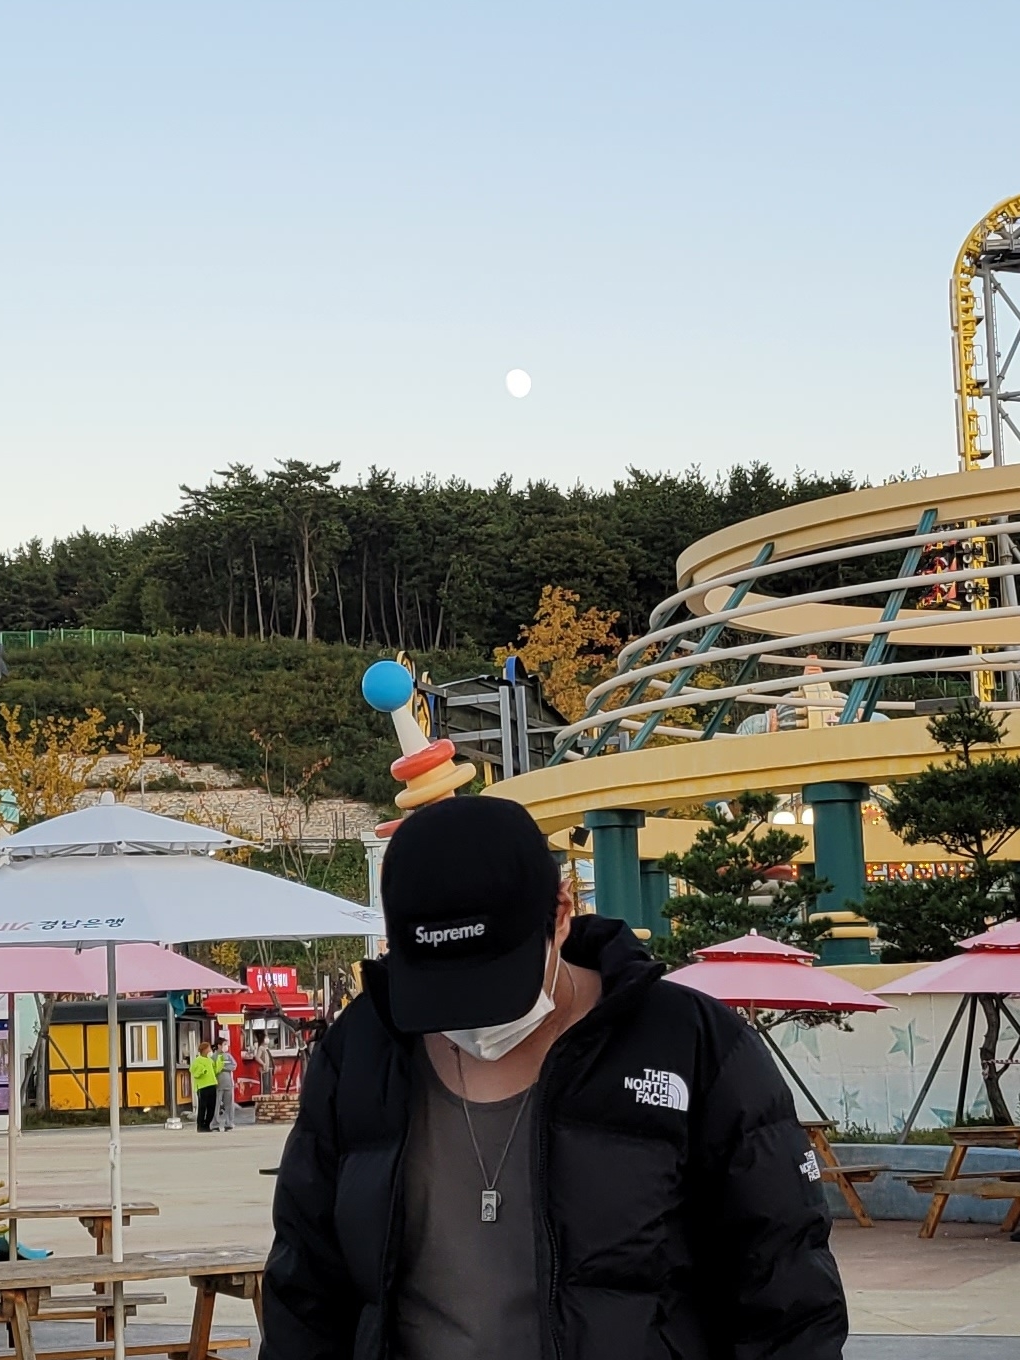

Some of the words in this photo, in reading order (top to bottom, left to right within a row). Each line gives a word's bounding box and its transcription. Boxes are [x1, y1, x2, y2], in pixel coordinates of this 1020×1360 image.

[38, 917, 125, 931] 경남은행
[415, 922, 485, 947] Supreme
[643, 1068, 669, 1083] THE
[624, 1076, 669, 1095] NORTH
[635, 1090, 669, 1107] FACE
